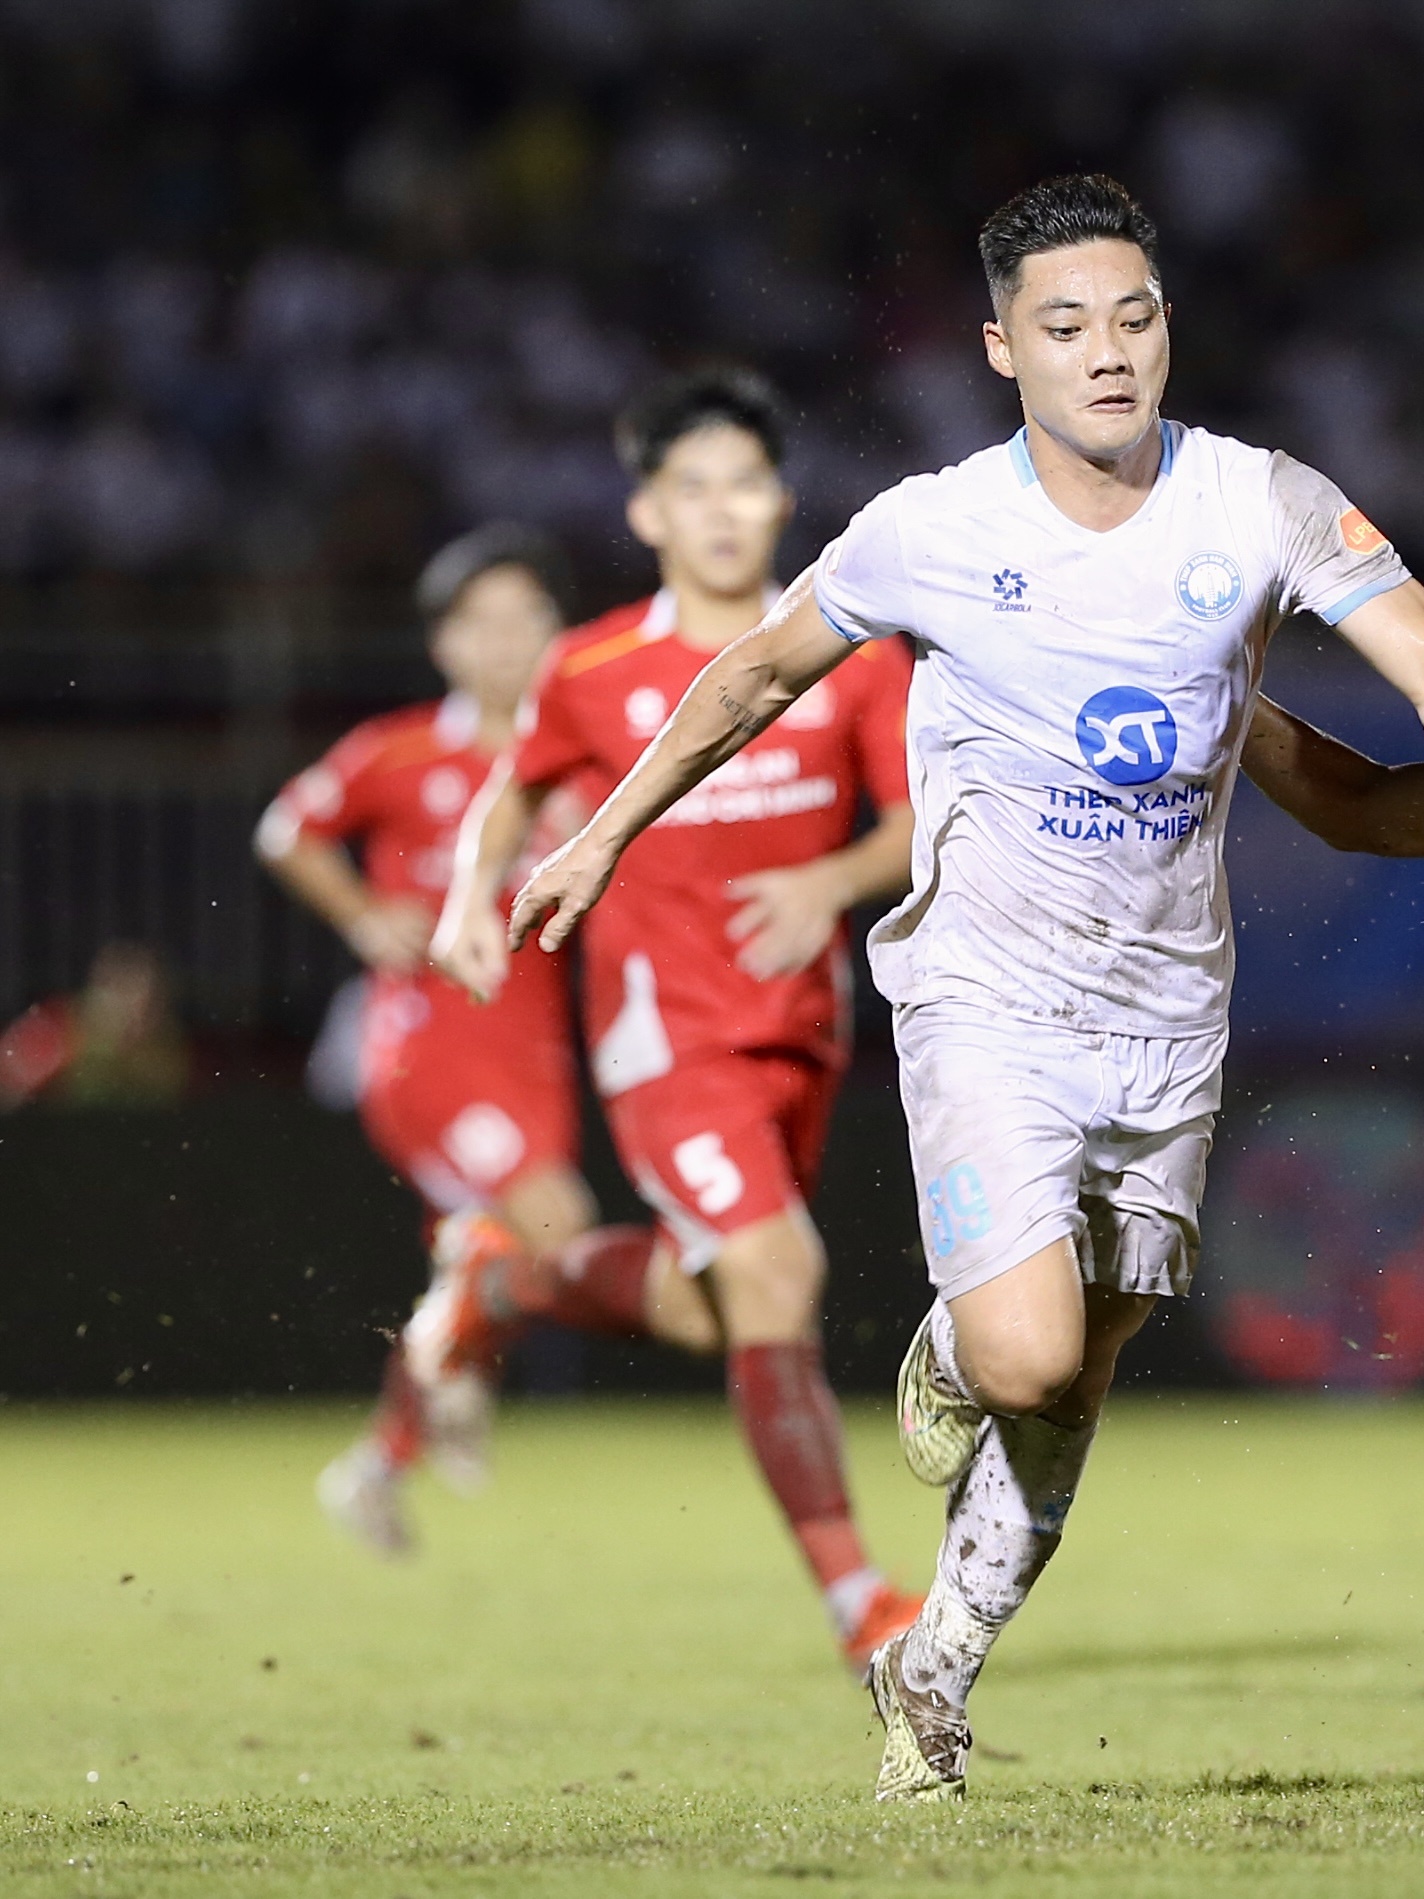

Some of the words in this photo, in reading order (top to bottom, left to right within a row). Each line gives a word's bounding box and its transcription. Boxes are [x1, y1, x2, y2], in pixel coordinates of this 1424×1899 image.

[1132, 781, 1207, 813] XANH
[1036, 812, 1125, 842] XUÂN
[671, 1130, 746, 1217] 5
